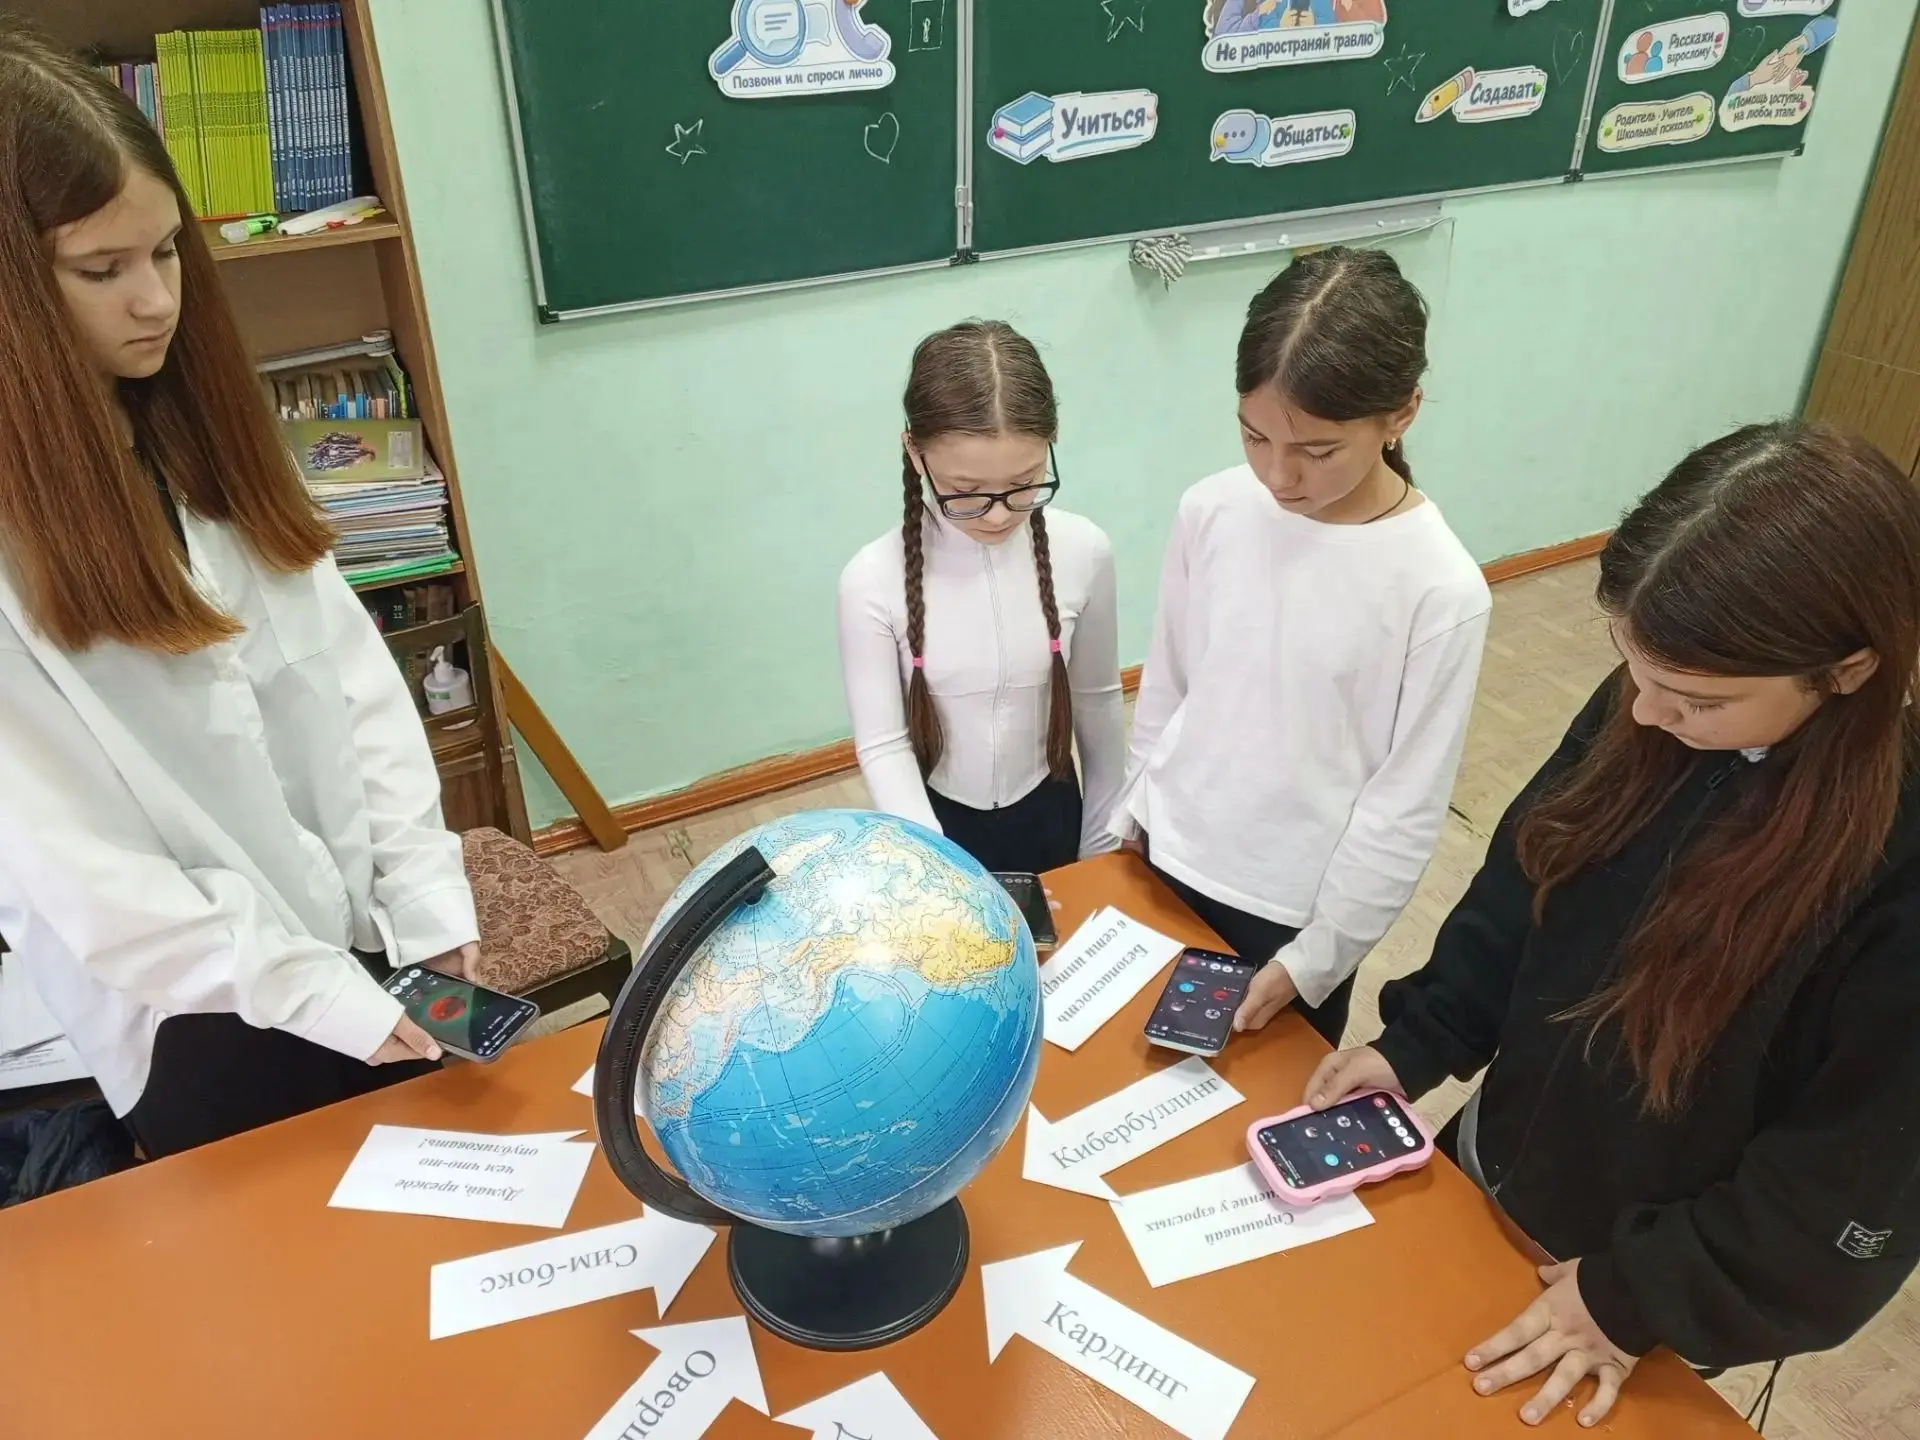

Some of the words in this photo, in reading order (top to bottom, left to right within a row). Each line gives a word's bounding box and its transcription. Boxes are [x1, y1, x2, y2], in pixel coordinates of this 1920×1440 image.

[1215, 43, 1237, 62] Не
[1666, 46, 1712, 67] врослому
[732, 75, 782, 89] Позвони
[807, 69, 845, 86] спроси
[849, 67, 883, 80] лично
[1061, 106, 1146, 140] Учиться
[1614, 112, 1656, 128] Родитель
[1273, 123, 1348, 148] Общаться
[1116, 919, 1127, 930] в
[1084, 927, 1118, 958] сети
[1041, 956, 1087, 999] интер
[1057, 943, 1148, 1022] Безопасность
[1050, 1077, 1218, 1170] Кибербуллинг
[417, 1137, 539, 1157] опубликовать!
[417, 1158, 480, 1172] что-то
[484, 1163, 515, 1175] чем
[394, 1178, 460, 1193] прежде
[463, 1184, 525, 1202] Думай,
[1220, 1199, 1229, 1214] у
[1232, 1189, 1280, 1210] нение
[1145, 1206, 1215, 1233] взрослых
[1204, 1211, 1295, 1246] Спрашивай
[479, 1244, 638, 1294] Сим-бокс
[1043, 1300, 1188, 1400] Кардинг
